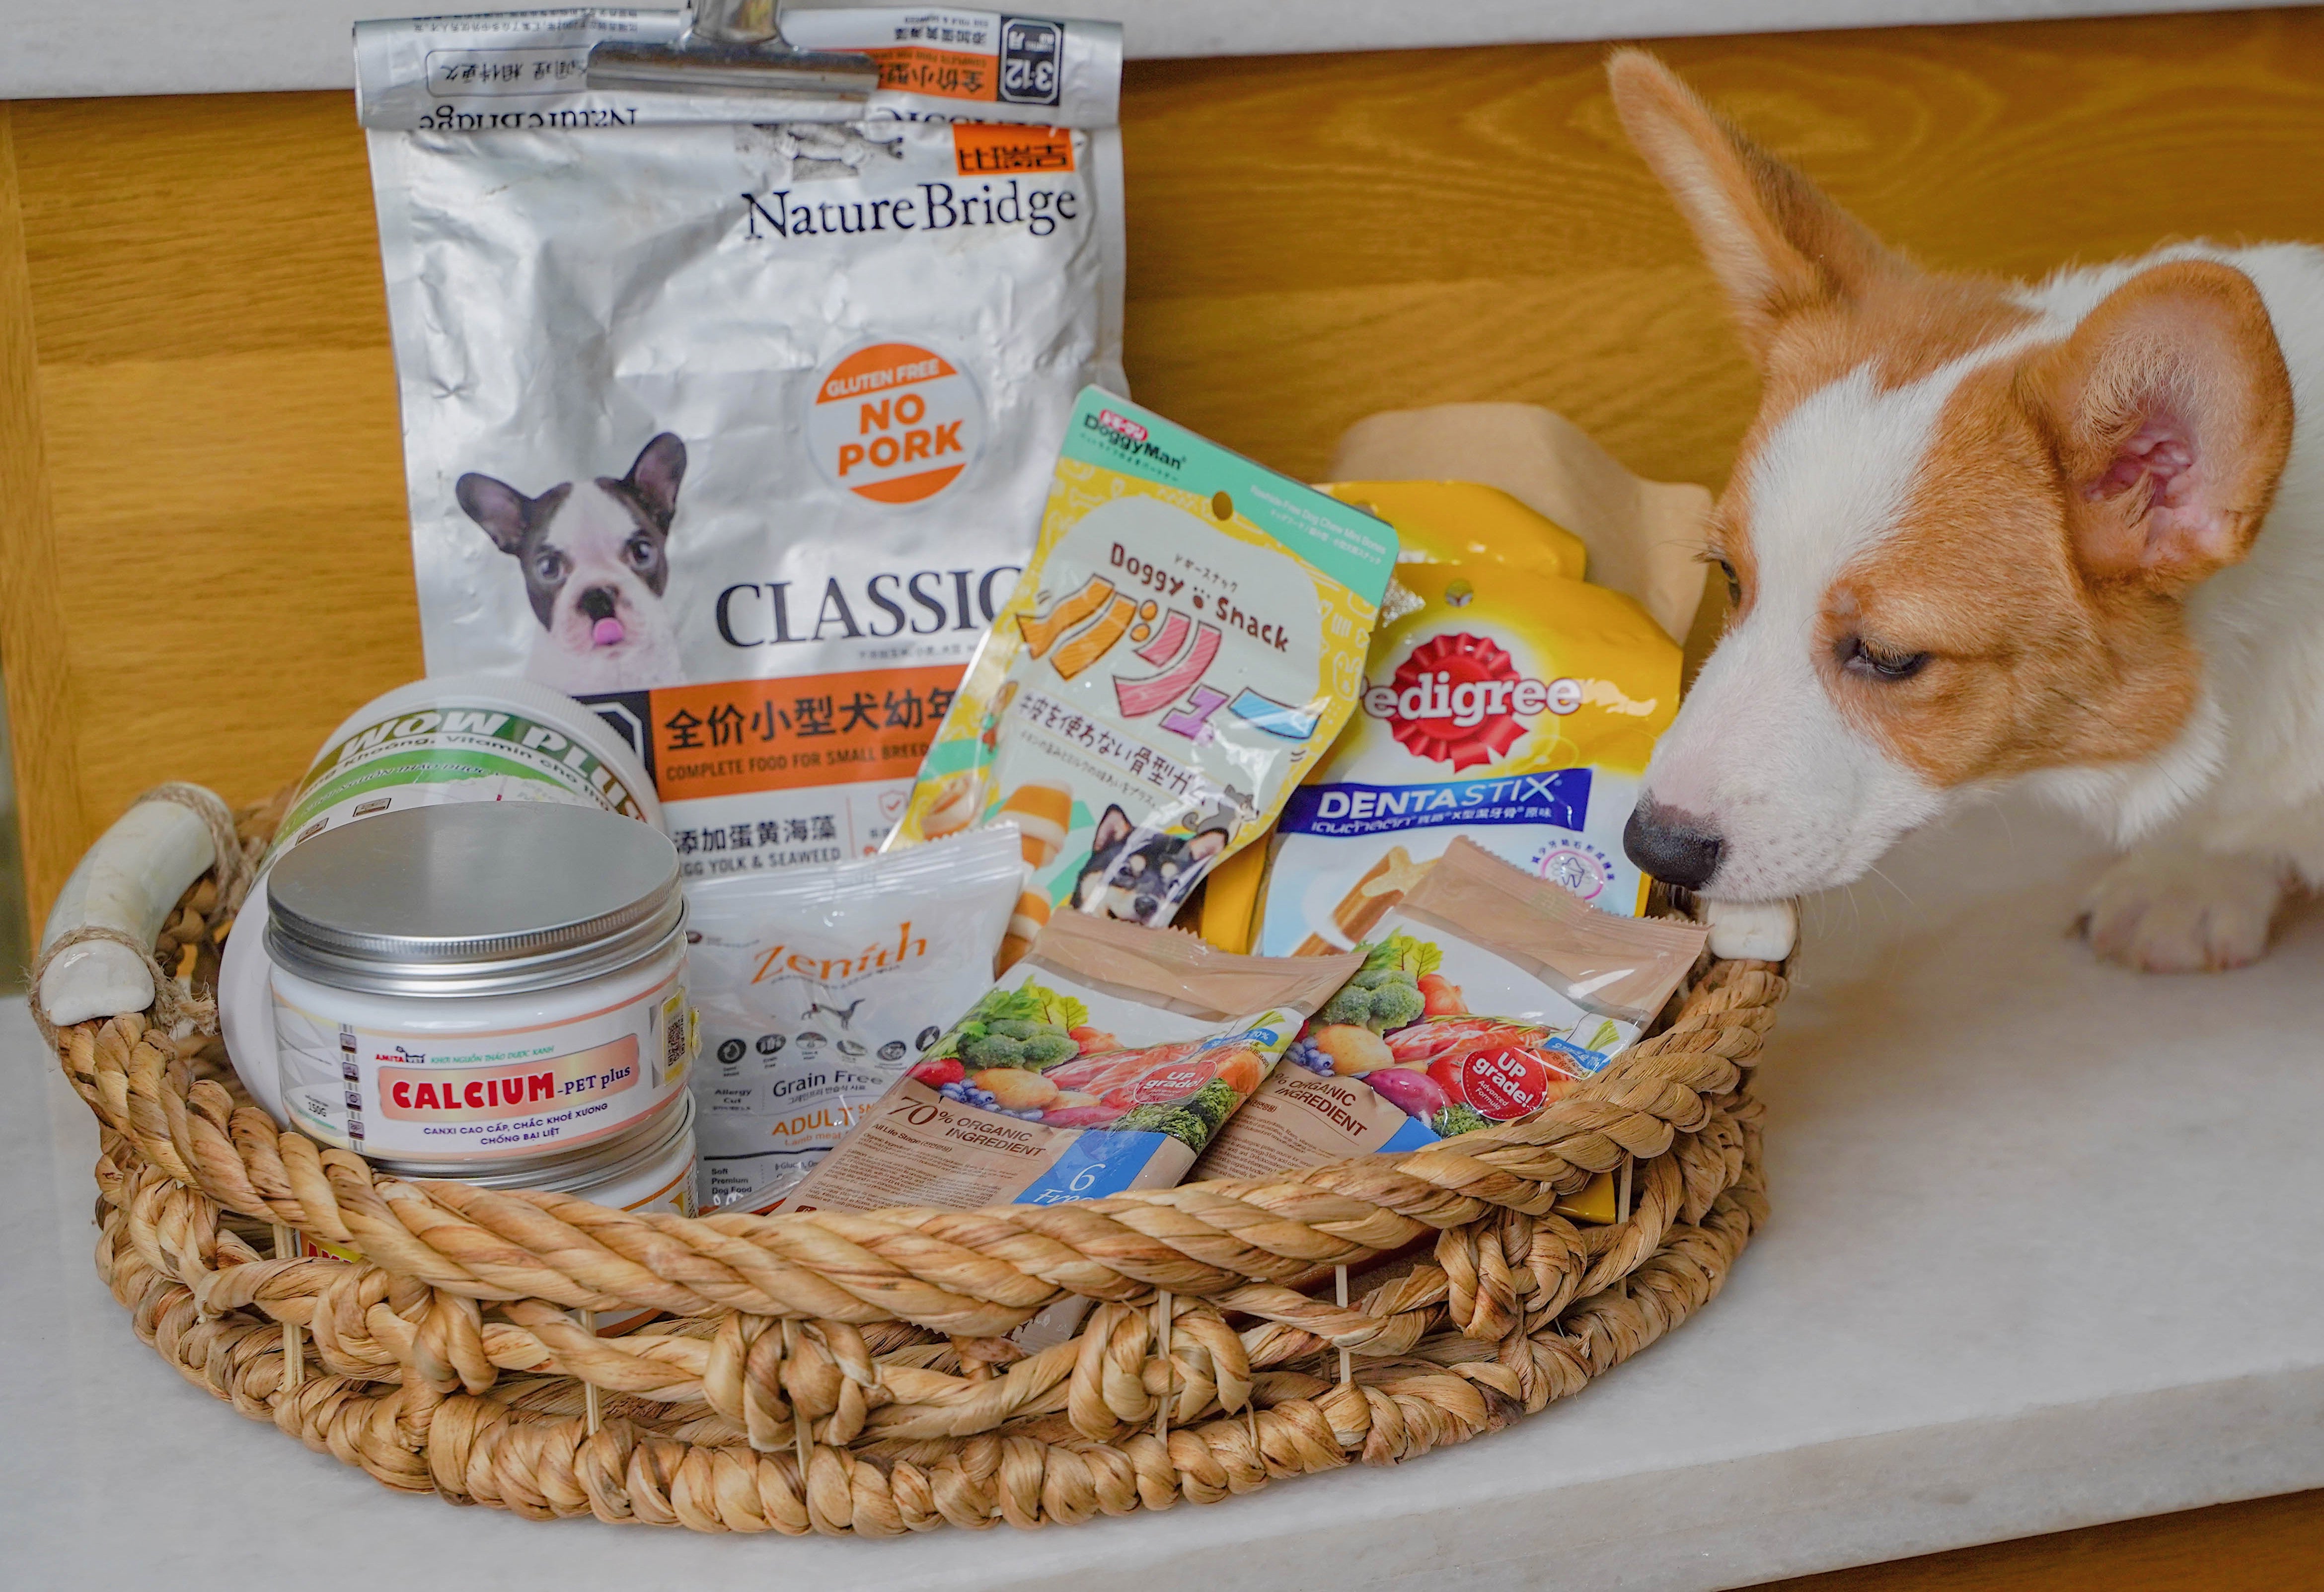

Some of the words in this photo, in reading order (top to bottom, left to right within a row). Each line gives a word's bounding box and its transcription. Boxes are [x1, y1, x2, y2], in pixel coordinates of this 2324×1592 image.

[879, 62, 985, 93] 全价小型
[742, 180, 1077, 240] NatureBridge
[826, 368, 894, 397] GLUTEN
[896, 358, 941, 383] FREE
[860, 393, 926, 435] NO
[837, 419, 965, 478] PORK
[715, 567, 1023, 649] CLASSIC
[1110, 542, 1184, 597] Doggy
[1216, 597, 1290, 652] Snack
[1361, 670, 1583, 728] edigree
[339, 710, 510, 762] WOW
[666, 762, 744, 782] COMPLETE
[748, 754, 787, 772] FOOD
[792, 751, 821, 769] FOR
[826, 748, 875, 766] SMALL
[1317, 773, 1560, 820] DENTASTIX
[710, 856, 749, 874] YOLK
[751, 853, 764, 868] &
[769, 847, 841, 867] SEAWEED
[750, 921, 927, 985] Zenith
[375, 1053, 404, 1063] AMITA
[1498, 1051, 1527, 1078] UP
[392, 1071, 555, 1110] CALCIUM
[600, 1066, 631, 1089] plus
[773, 1071, 825, 1097] Grain
[834, 1070, 884, 1085] Free
[1143, 1077, 1204, 1089] grade!
[1167, 1071, 1196, 1080] UP
[1472, 1057, 1534, 1108] grade!
[1289, 1080, 1356, 1107] ORGANIC
[1475, 1087, 1501, 1111] Formula
[1478, 1080, 1509, 1107] Advanced
[772, 1106, 854, 1137] ADULT
[887, 1096, 954, 1126] 70%
[1274, 1087, 1368, 1138] INGREDIENT
[423, 1125, 457, 1135] CANXI
[460, 1126, 483, 1135] CAO
[480, 1133, 521, 1146] CHỐNG
[523, 1132, 540, 1143] BẠI
[784, 1135, 813, 1147] Lamb
[815, 1132, 841, 1141] meat
[872, 1123, 885, 1133] All
[884, 1126, 898, 1137] Life
[898, 1133, 920, 1145] Stage
[945, 1127, 1047, 1157] INGREDIENT
[957, 1117, 1033, 1142] ORGANIC
[711, 1176, 749, 1185] Premium
[711, 1187, 729, 1196] Dog
[731, 1185, 752, 1194] Food
[1069, 1163, 1107, 1192] 6
